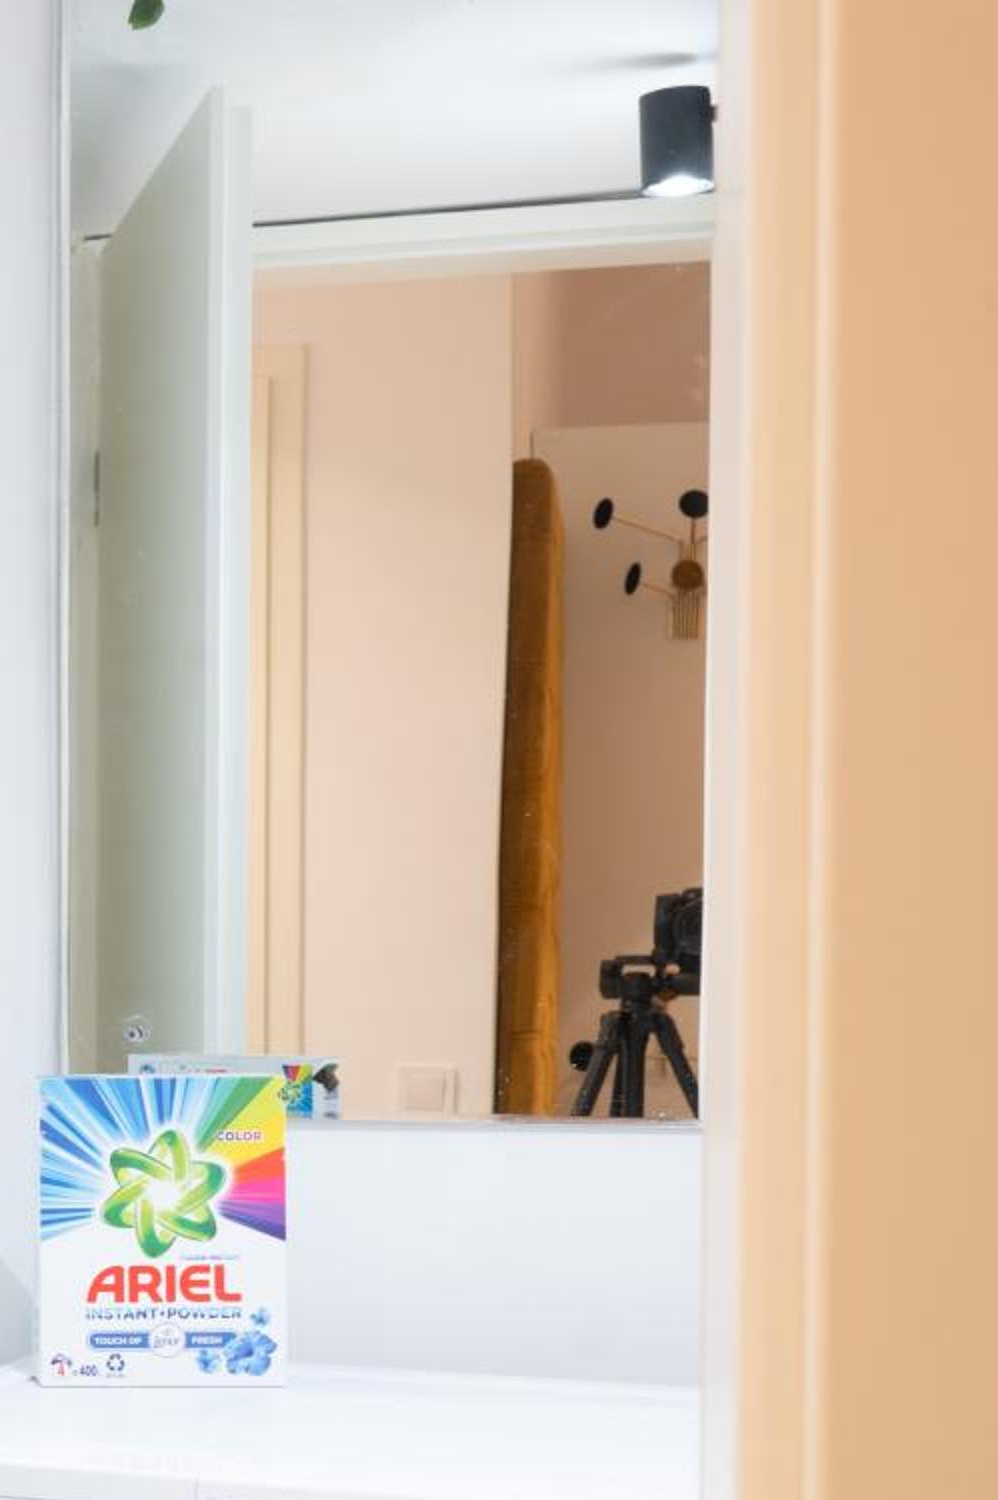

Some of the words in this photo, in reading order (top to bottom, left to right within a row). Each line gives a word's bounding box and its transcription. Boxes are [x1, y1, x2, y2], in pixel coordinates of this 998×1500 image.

[217, 1131, 261, 1141] COLOR
[86, 1264, 242, 1304] ARIEL
[94, 1336, 127, 1345] TOUCH
